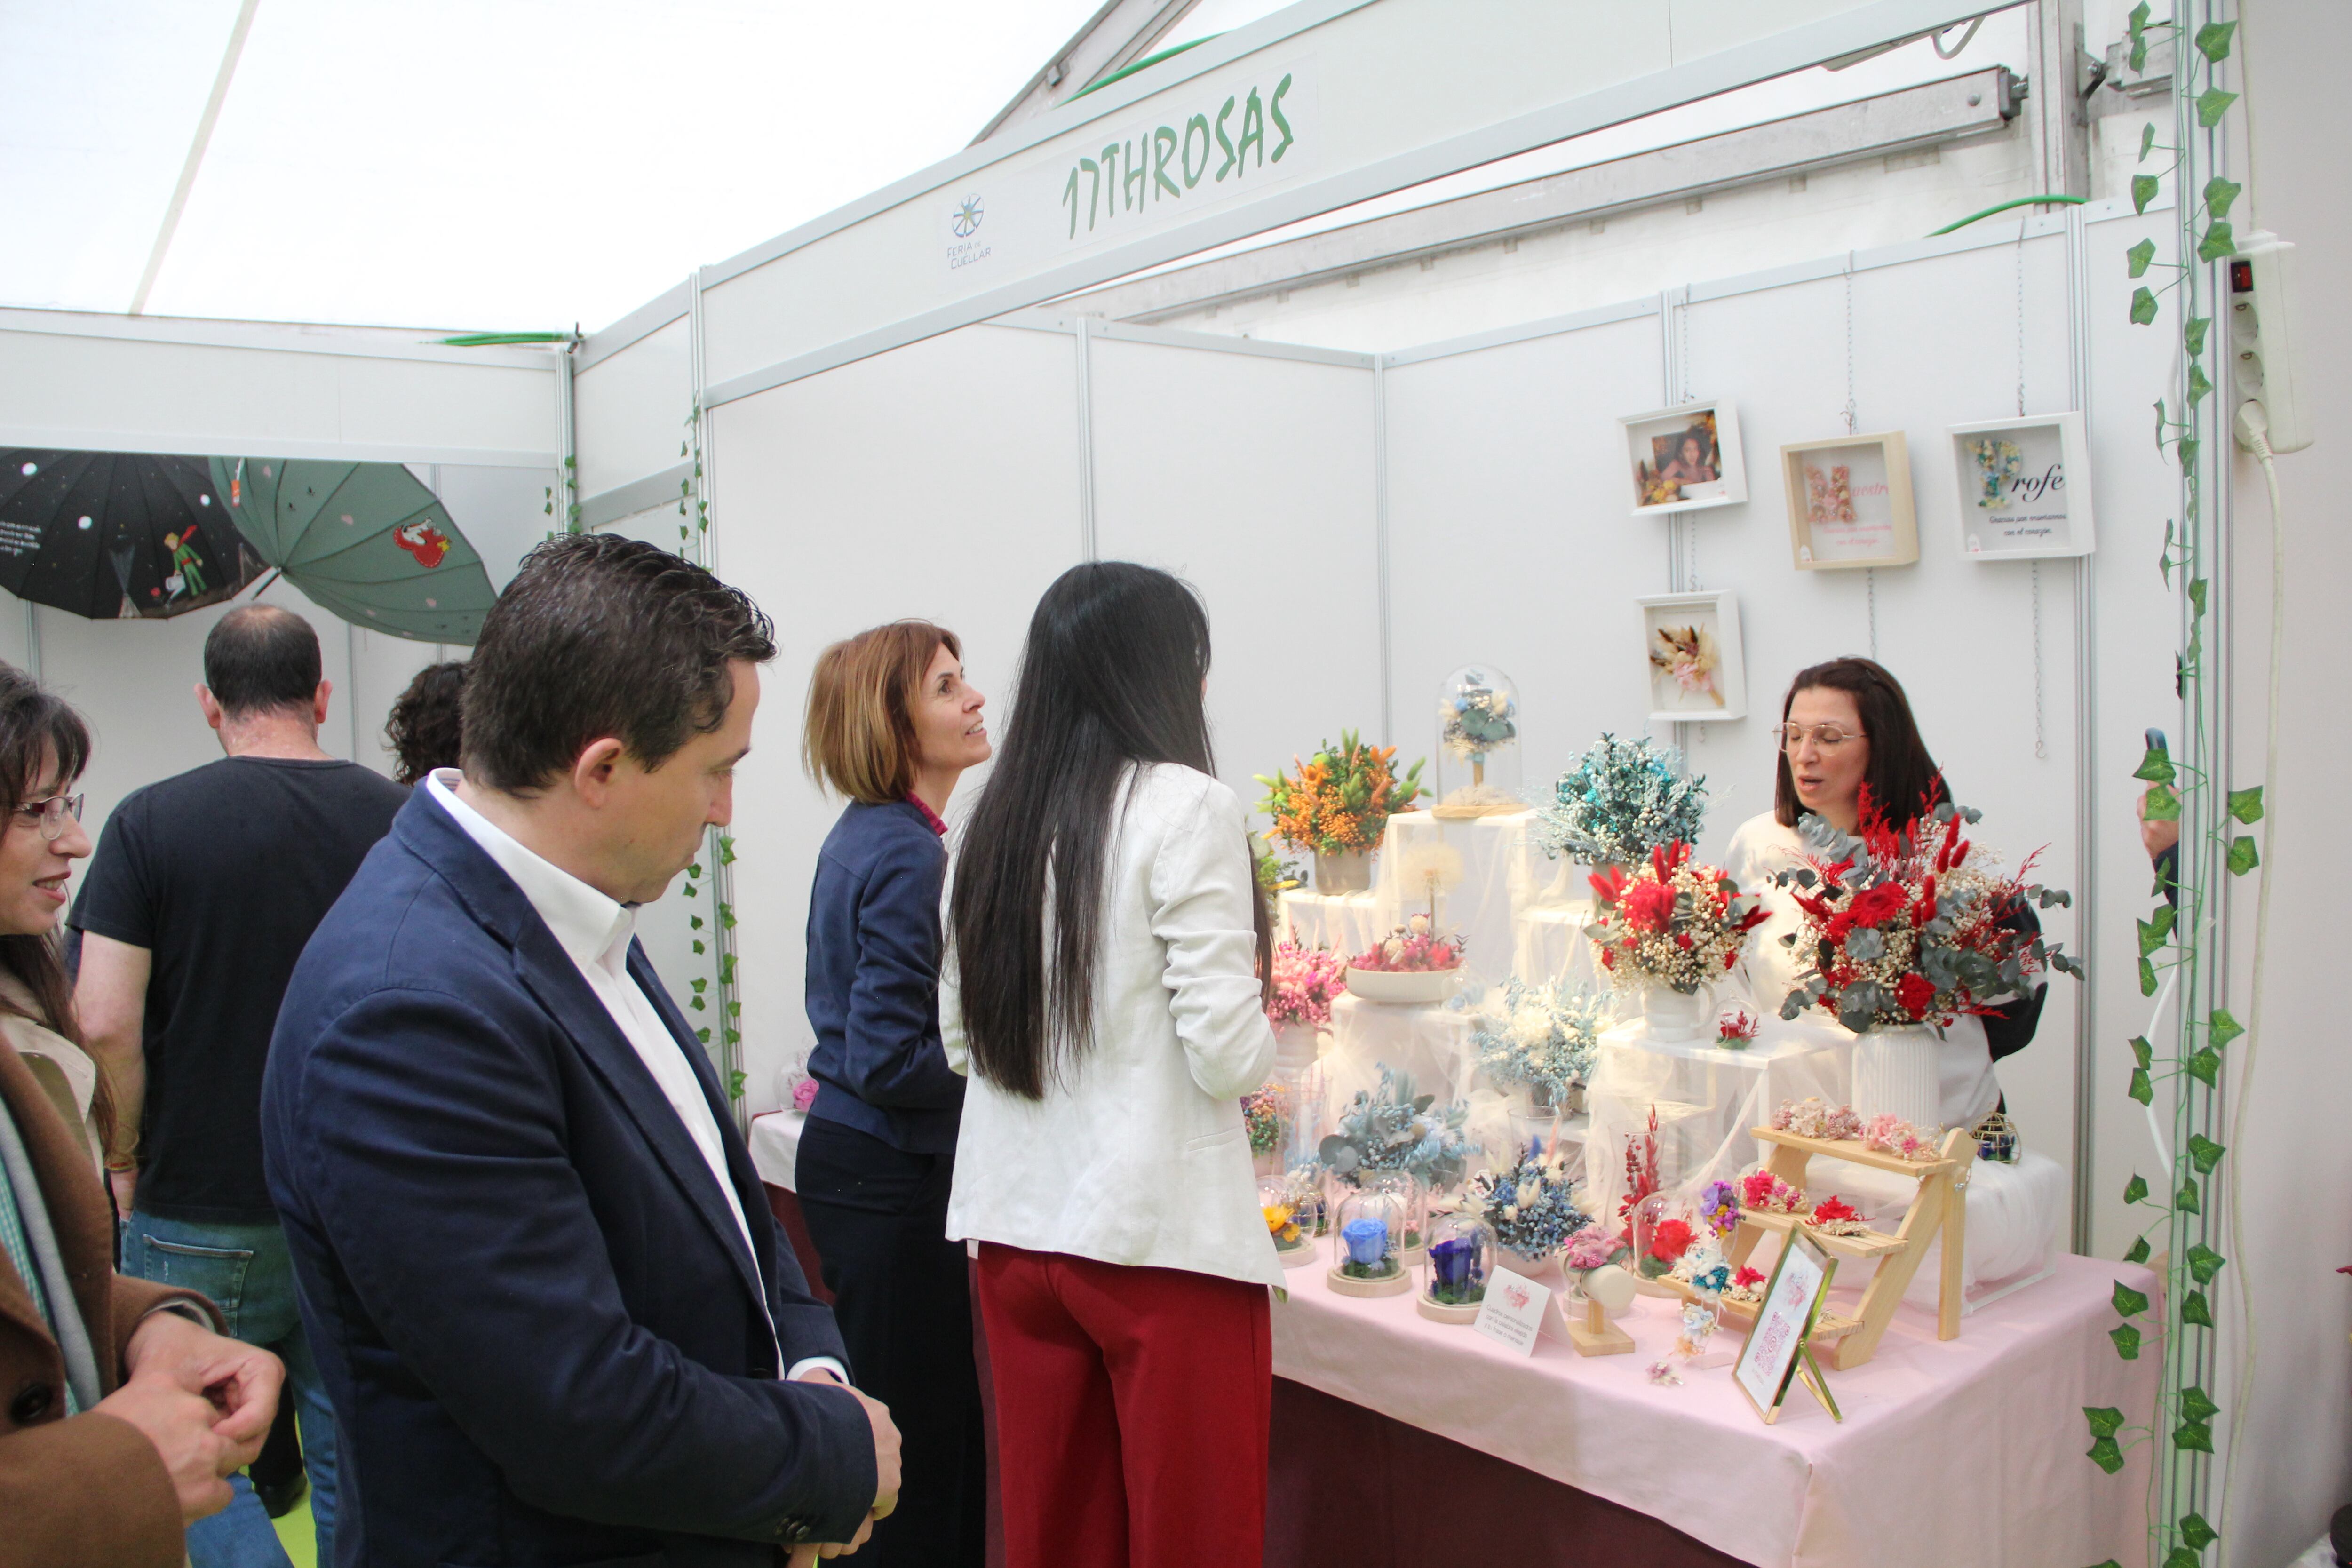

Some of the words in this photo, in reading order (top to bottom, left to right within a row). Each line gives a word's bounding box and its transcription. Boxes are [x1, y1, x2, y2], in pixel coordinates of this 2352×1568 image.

[1063, 73, 1294, 240] 17THROSAS
[947, 242, 972, 258] FERIA
[1486, 1304, 1503, 1317] Cuadros
[1503, 1313, 1532, 1331] personalizados
